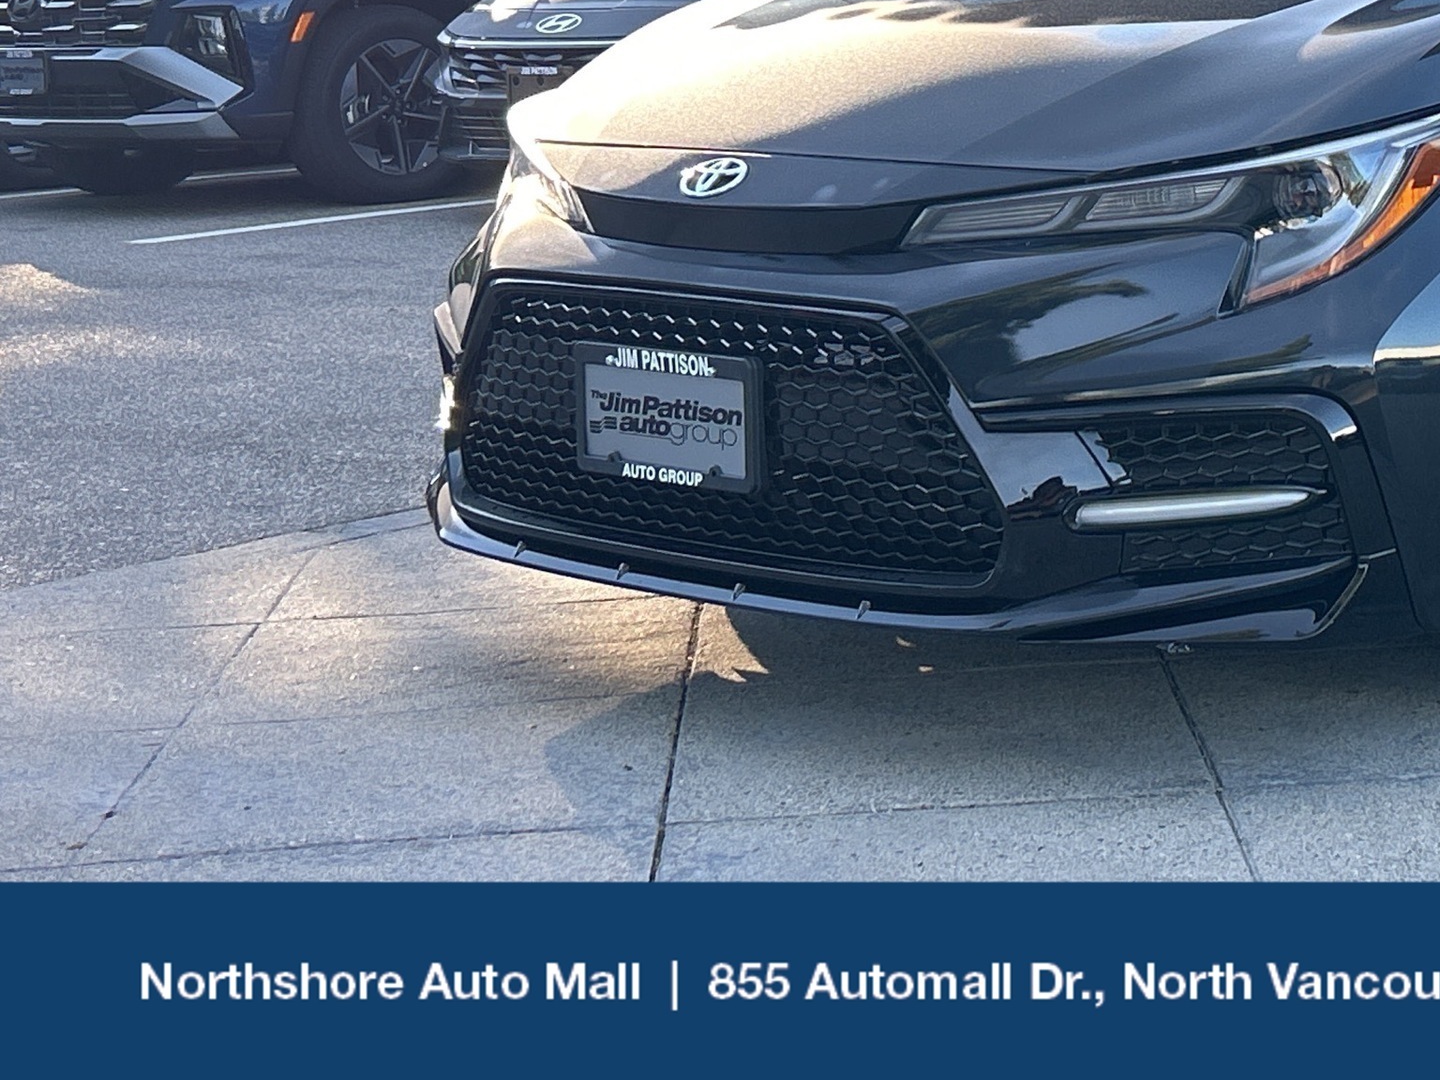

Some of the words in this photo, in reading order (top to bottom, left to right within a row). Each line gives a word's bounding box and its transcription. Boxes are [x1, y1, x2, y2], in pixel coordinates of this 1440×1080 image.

[614, 347, 638, 370] JIM
[641, 350, 710, 376] PATTISON
[622, 462, 656, 481] AUTO
[658, 467, 704, 487] GROUP
